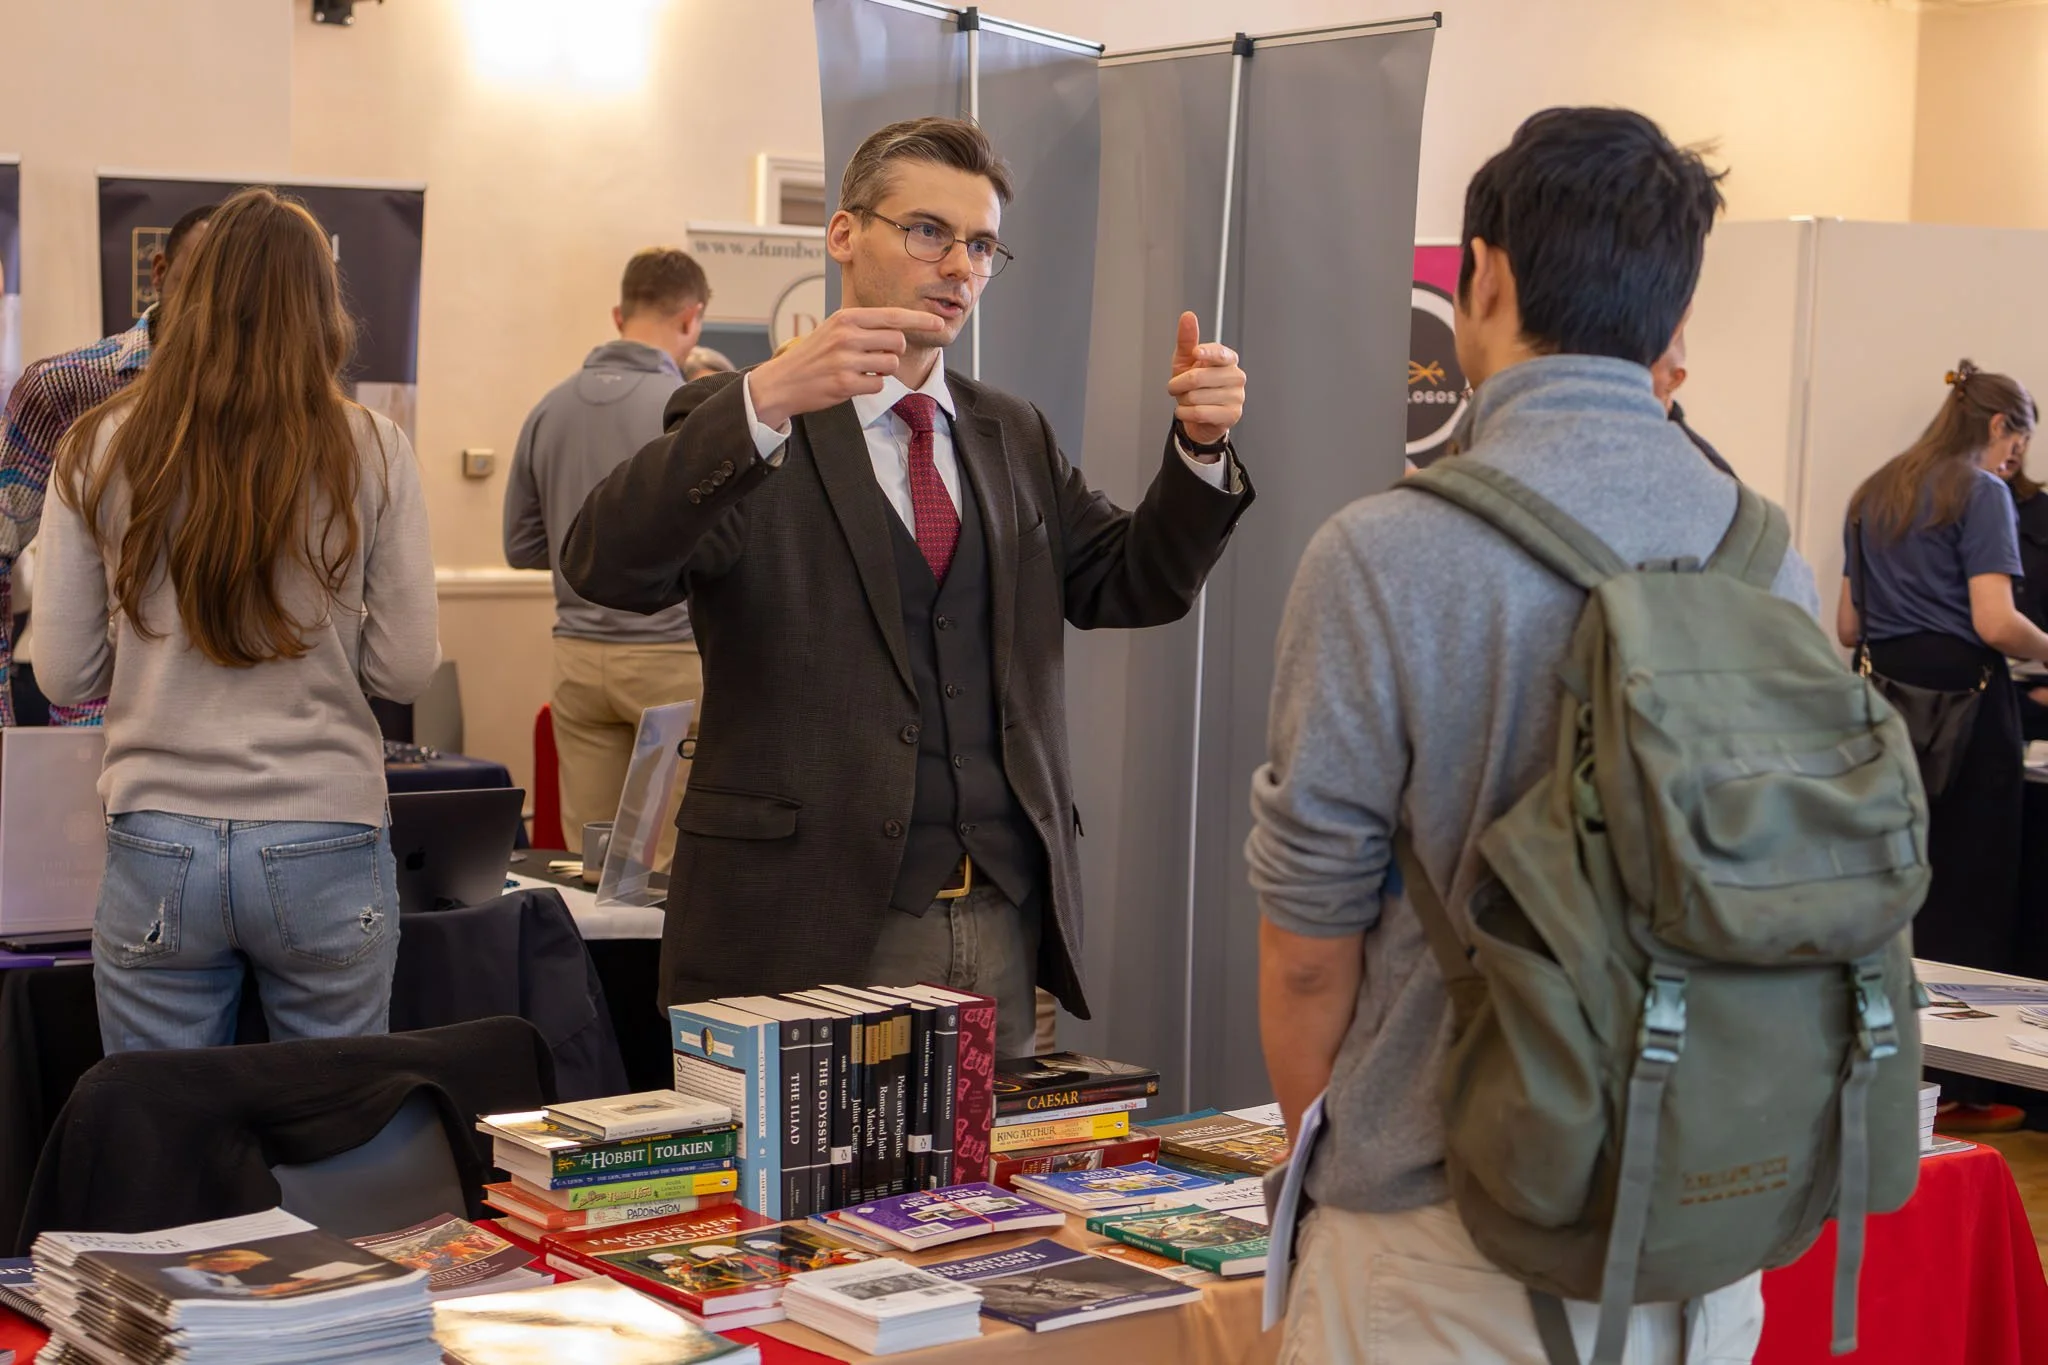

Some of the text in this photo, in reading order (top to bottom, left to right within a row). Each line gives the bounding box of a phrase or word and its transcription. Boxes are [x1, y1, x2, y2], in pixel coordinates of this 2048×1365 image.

[790, 1072, 800, 1145] THE ILIAD
[817, 1058, 829, 1154] THE ODYSSEY
[1027, 1090, 1079, 1110] CAESAR
[851, 1098, 861, 1155] Julius Caesar
[866, 1108, 876, 1147] Macbeth
[878, 1086, 888, 1160] Romeo and Juliet
[895, 1075, 906, 1158] Pride and Prejudice
[996, 1131, 1019, 1142] KING
[1019, 1126, 1057, 1139] ARTHUR
[591, 1149, 646, 1169] HOBBIT
[654, 1141, 714, 1159] TOLKIEN
[626, 1203, 681, 1219] PADDINGTON
[899, 1199, 931, 1210] ART
[587, 1227, 685, 1246] FAMOUS
[687, 1216, 743, 1232] MEN
[625, 1237, 658, 1248] OF
[663, 1226, 733, 1243] ROME
[929, 1250, 1033, 1274] THE BRITISH
